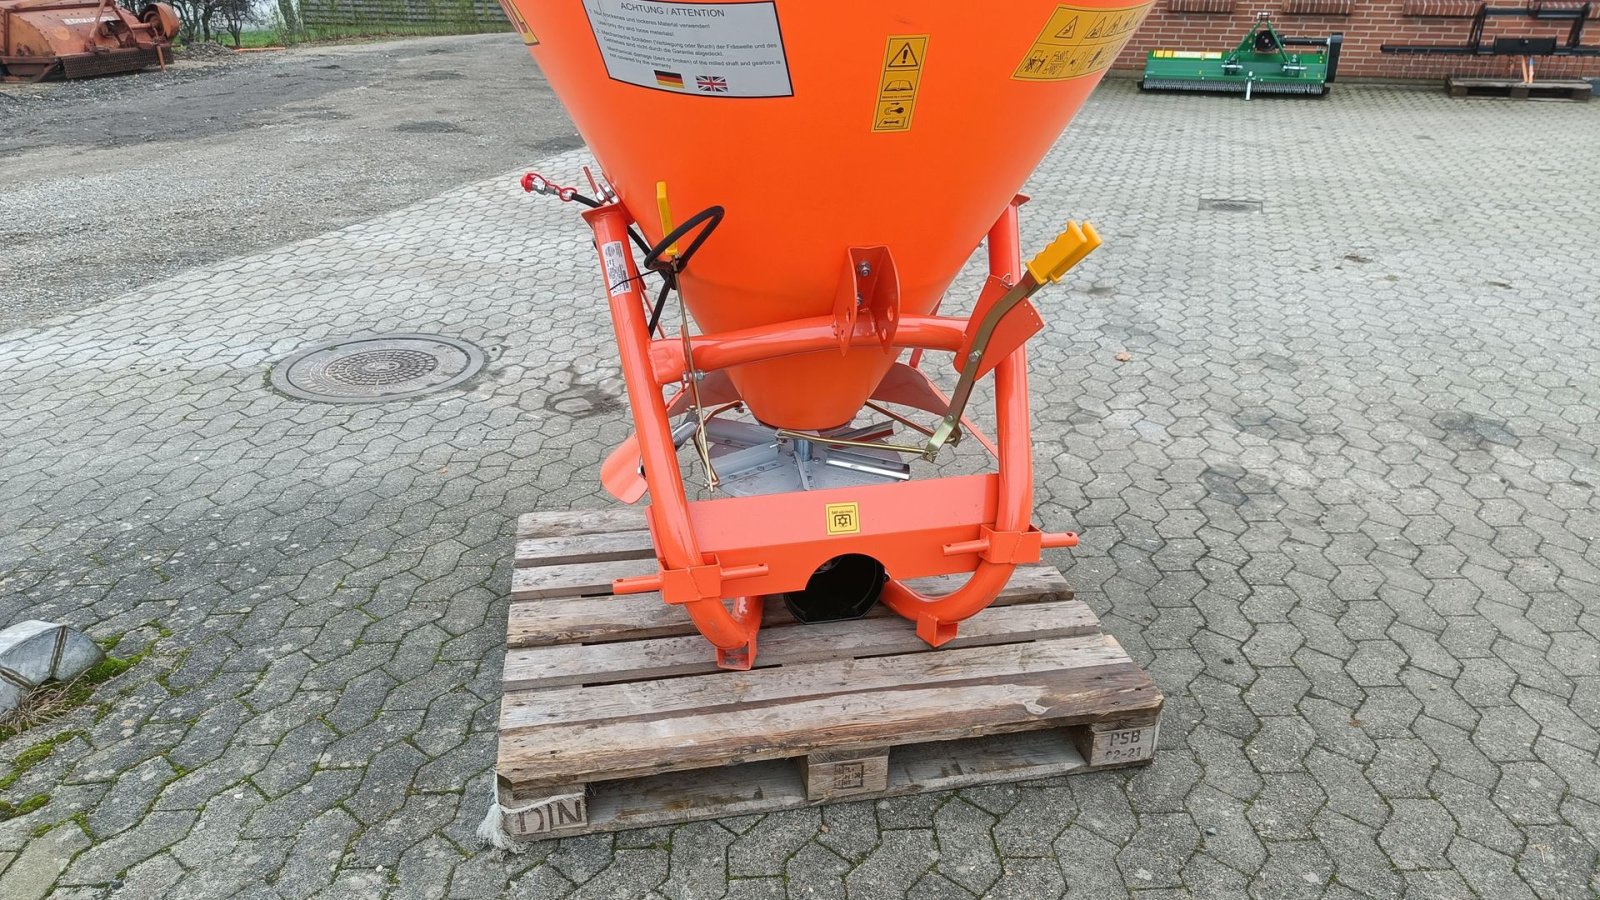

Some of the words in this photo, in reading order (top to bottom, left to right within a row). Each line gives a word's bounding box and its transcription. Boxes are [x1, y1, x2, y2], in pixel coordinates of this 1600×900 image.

[620, 2, 664, 15] ACHTUNG
[671, 7, 725, 17] ATTENTION
[1109, 730, 1141, 747] PSB
[518, 800, 582, 833] DIN
